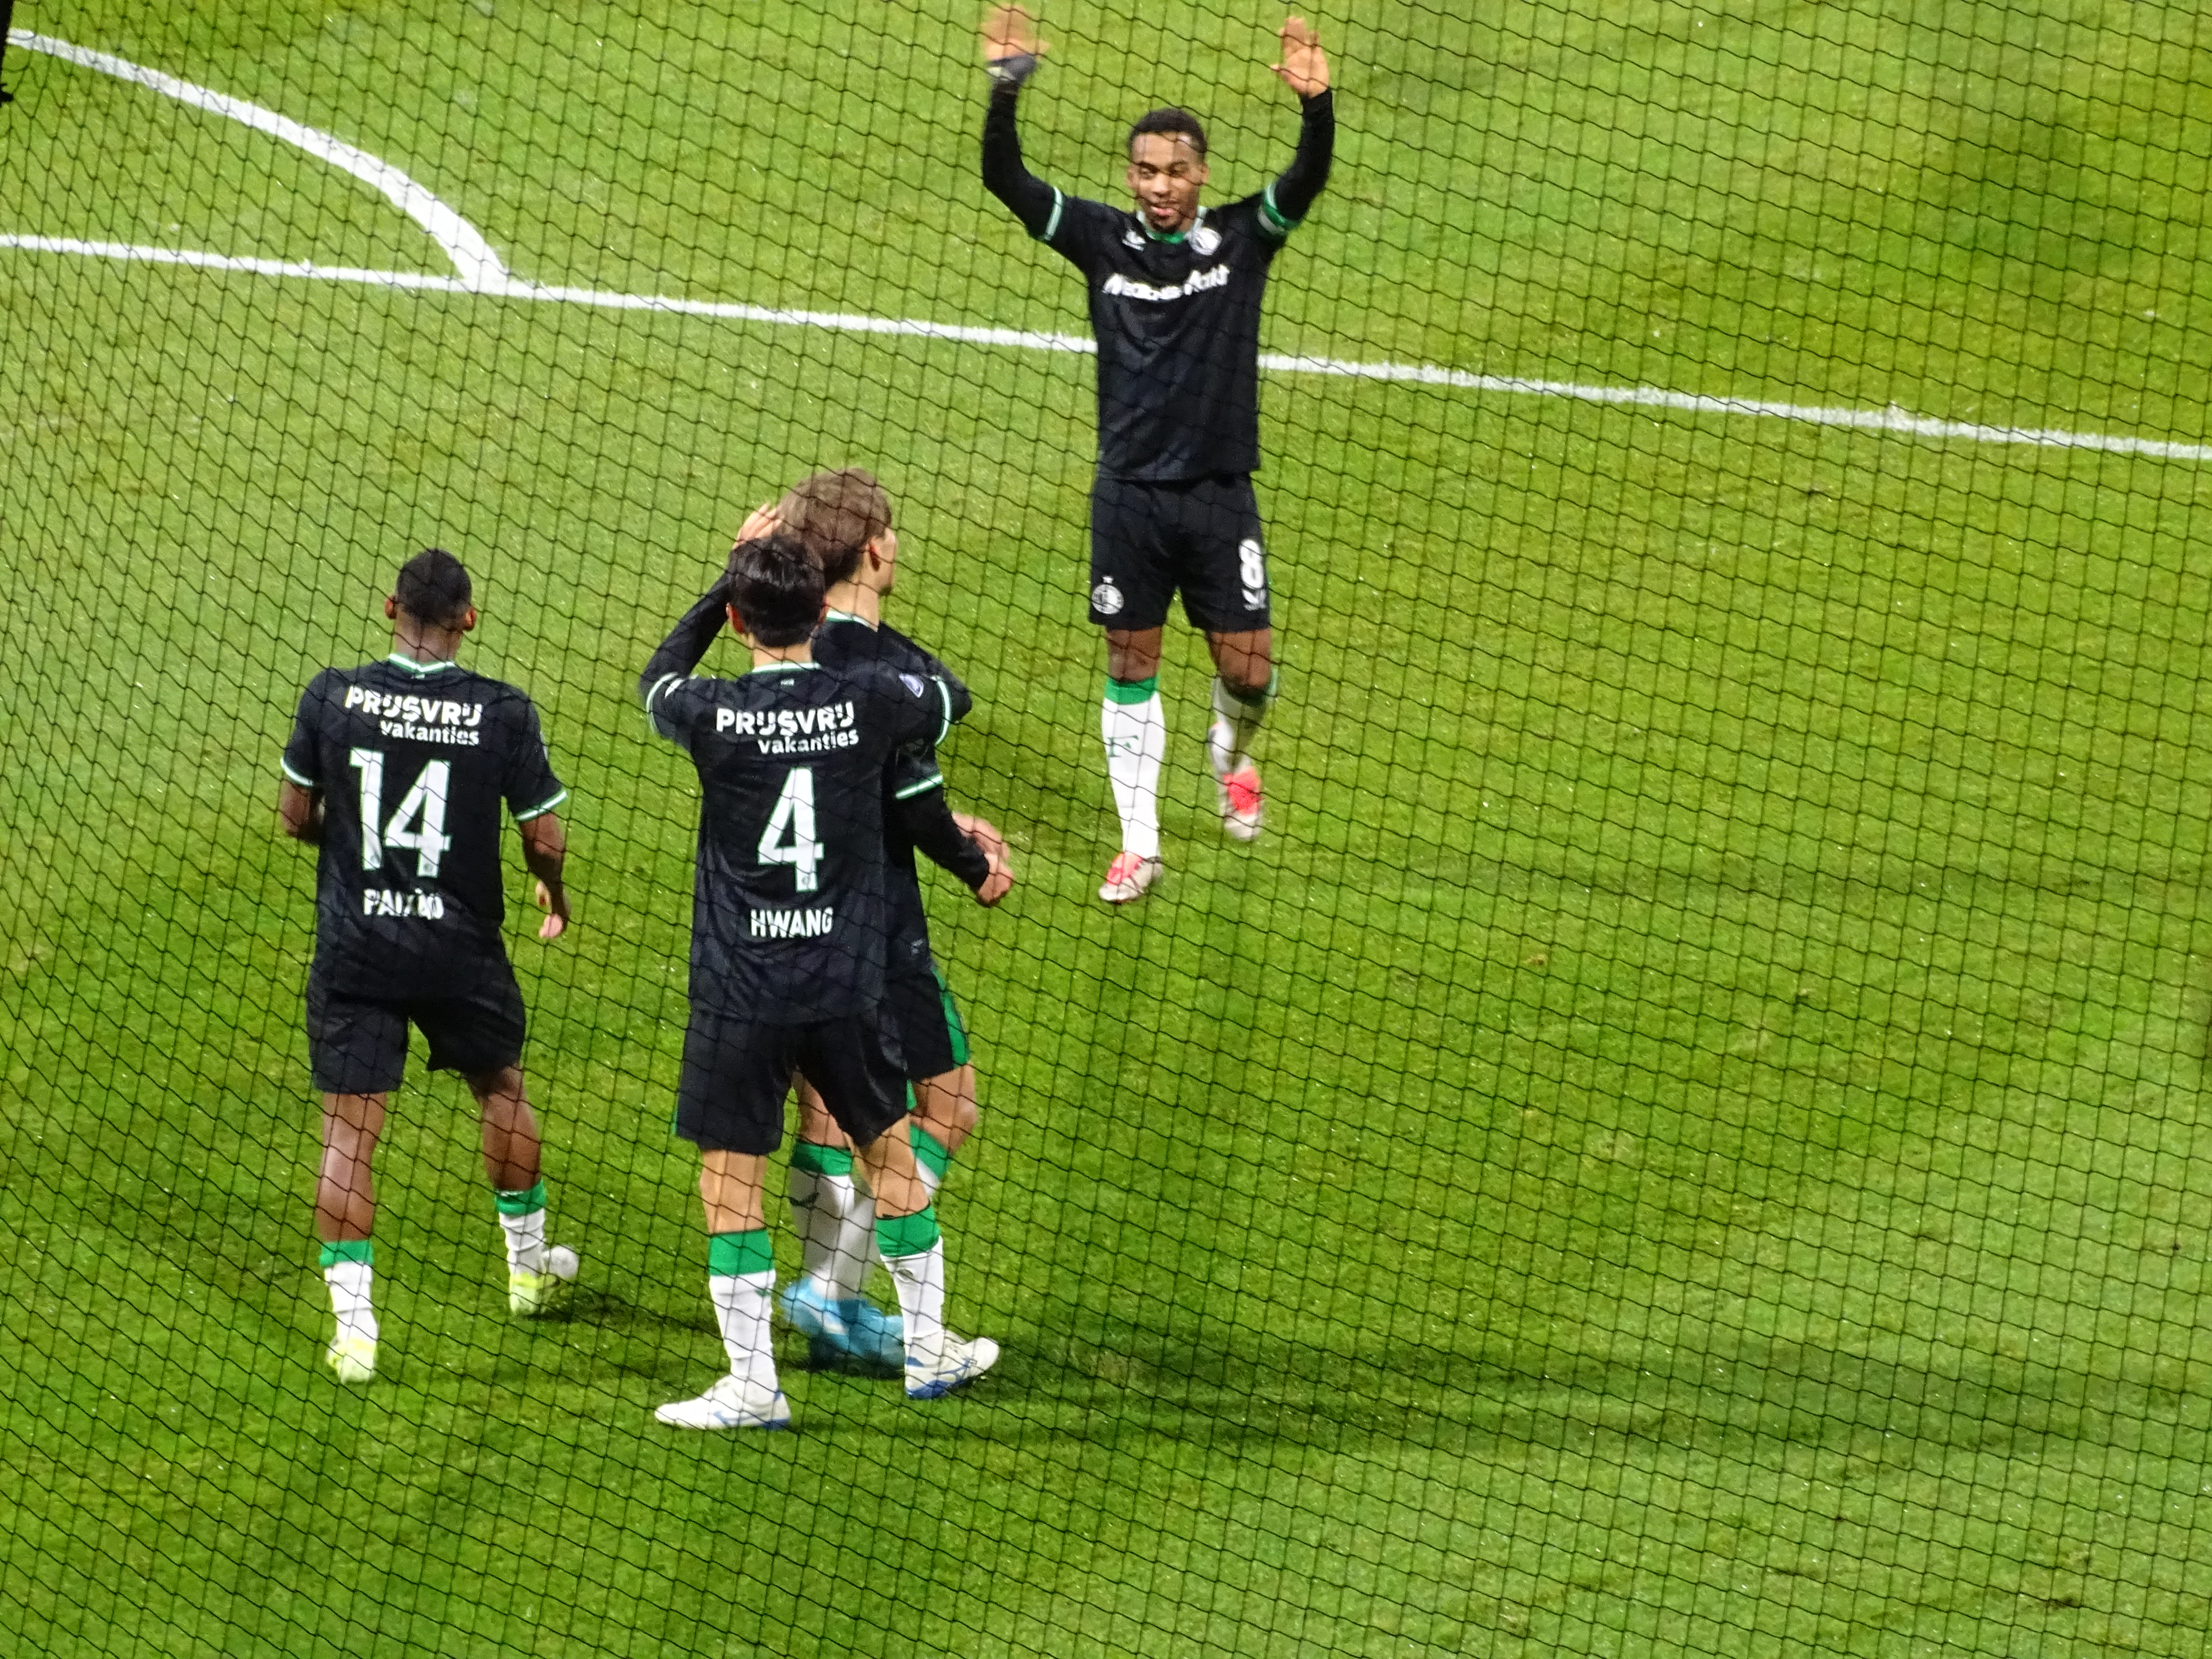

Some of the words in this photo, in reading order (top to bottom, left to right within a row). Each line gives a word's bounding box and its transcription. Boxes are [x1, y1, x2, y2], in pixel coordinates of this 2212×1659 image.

[1238, 538, 1264, 590] 8
[380, 720, 480, 746] vakanties
[757, 728, 859, 754] vakanties
[349, 747, 451, 877] 14
[758, 767, 824, 892] 4
[750, 907, 833, 938] HWANG
